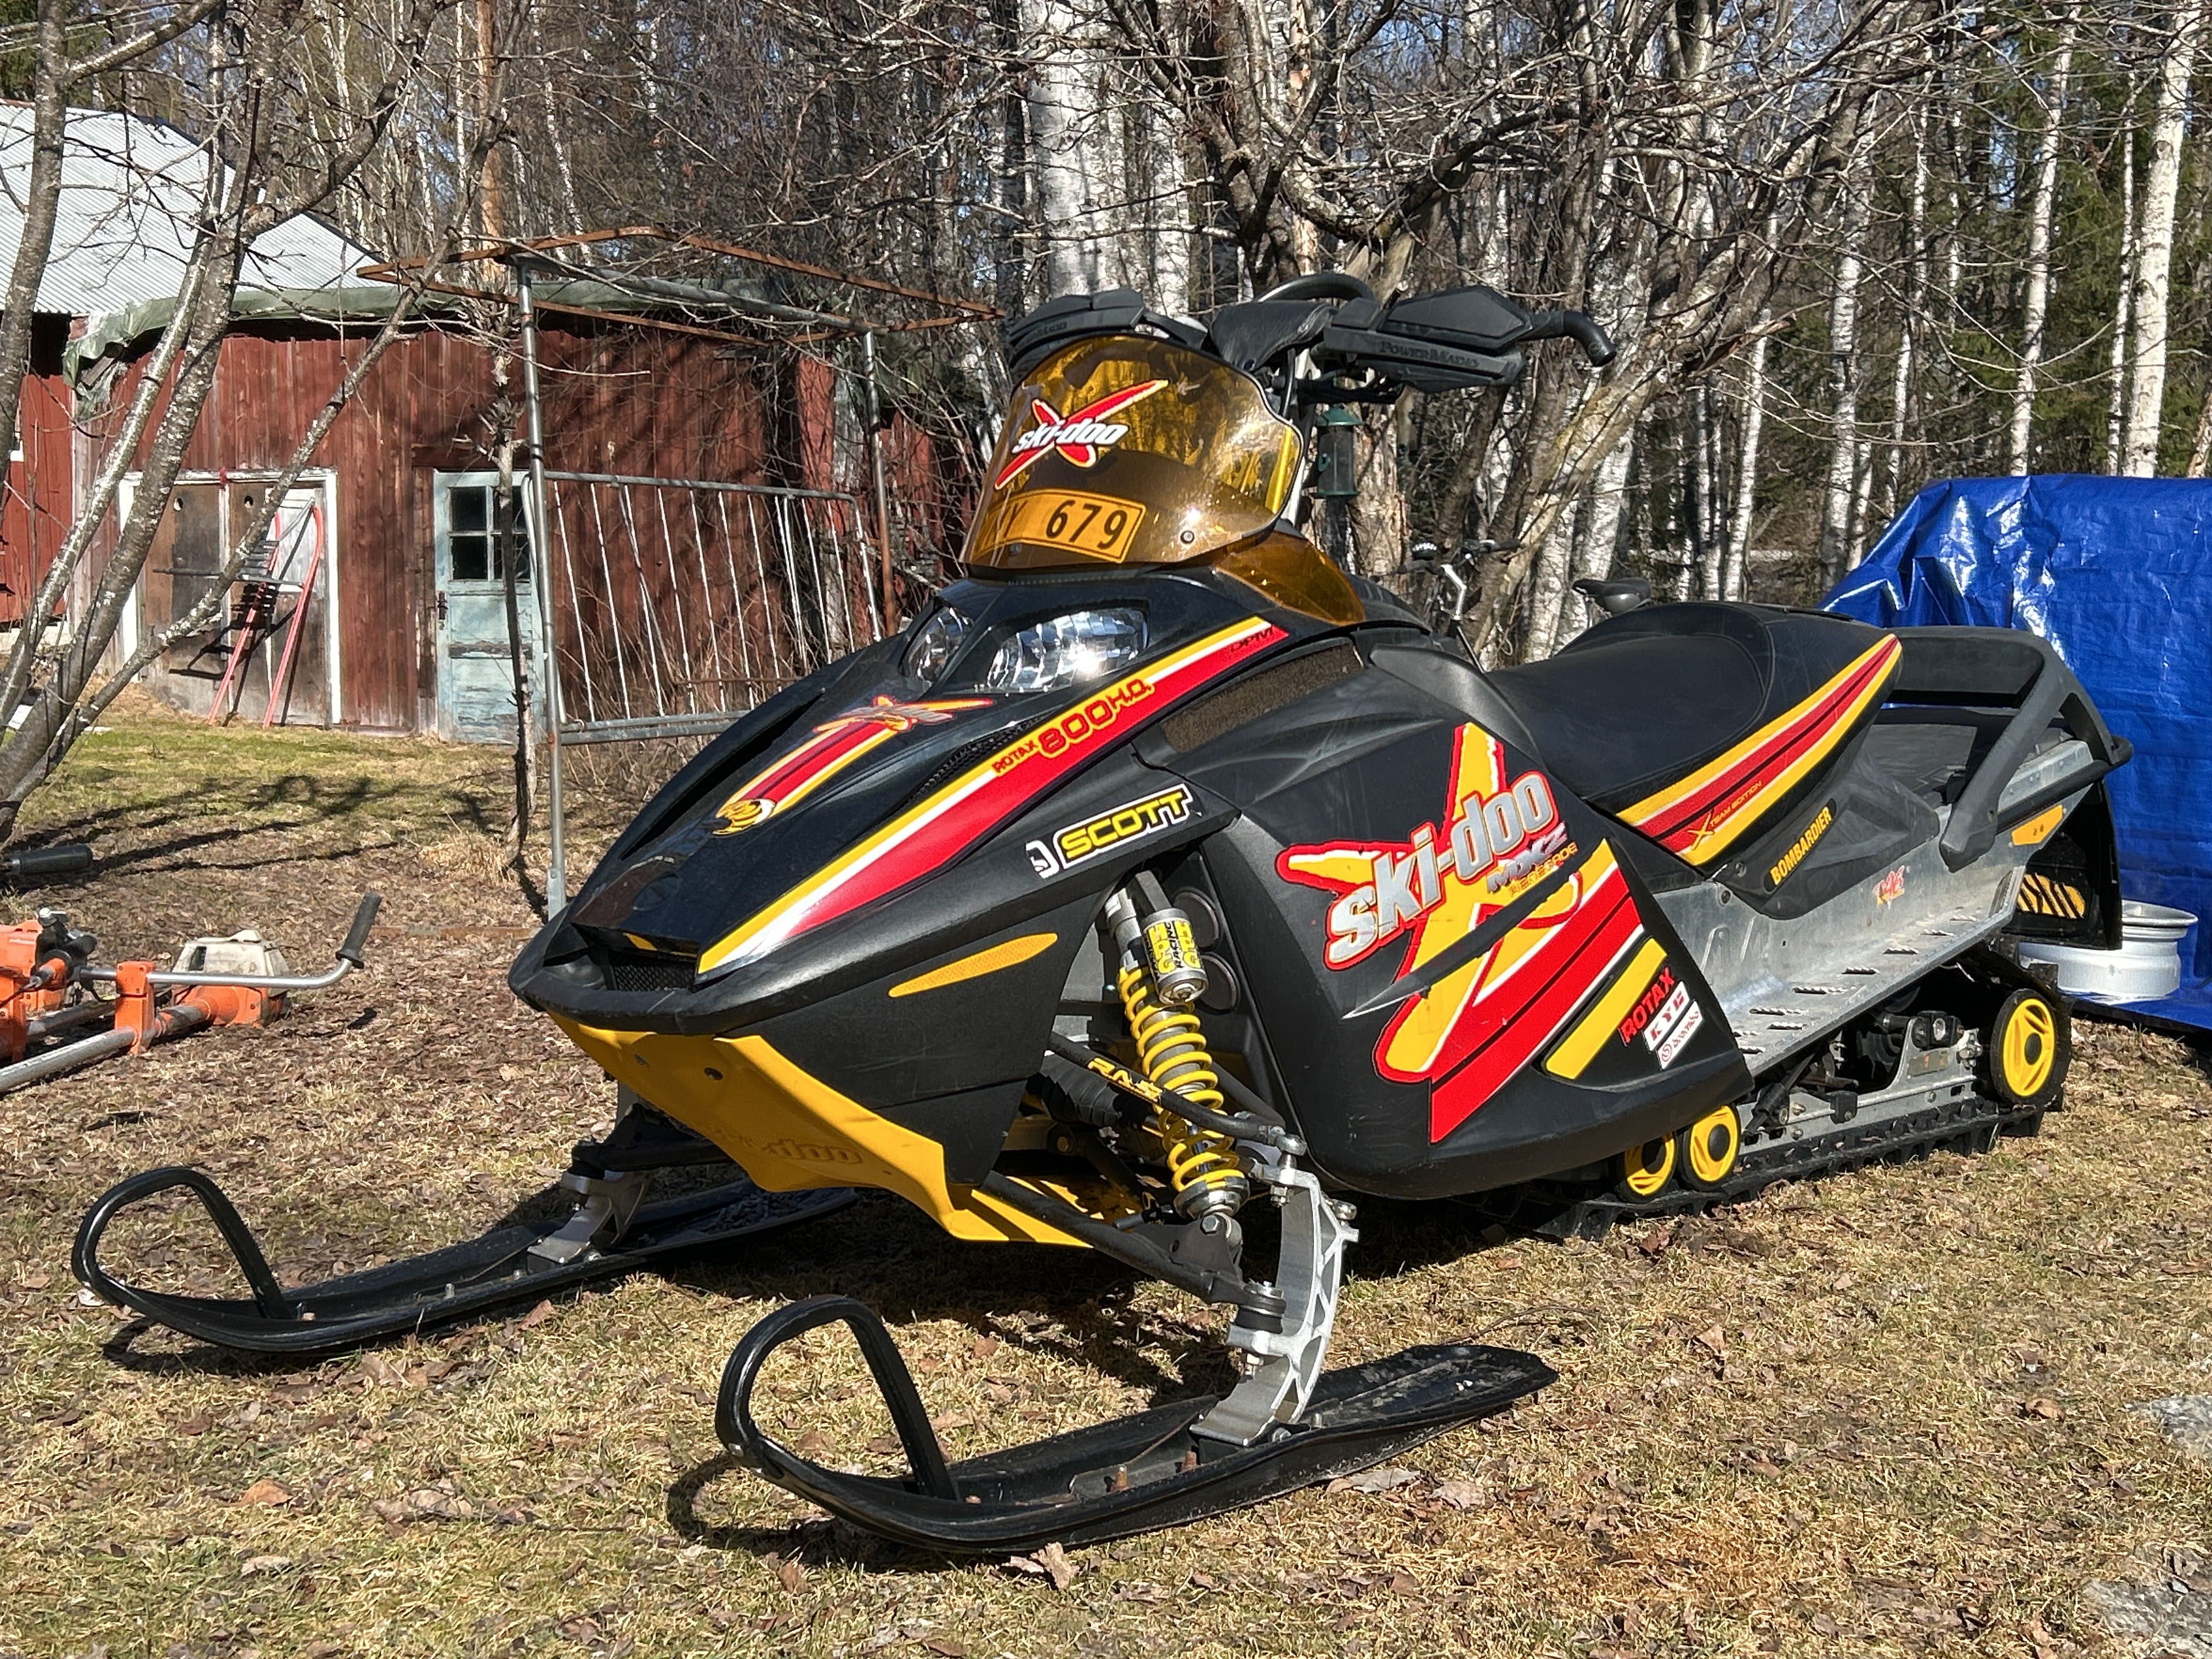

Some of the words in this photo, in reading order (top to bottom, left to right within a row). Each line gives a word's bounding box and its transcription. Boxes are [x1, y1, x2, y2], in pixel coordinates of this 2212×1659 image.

[1012, 417, 1128, 454] ski-doo
[1046, 499, 1128, 549] 679
[992, 740, 1039, 774] ROTAX
[1039, 700, 1113, 754] 800
[1061, 792, 1183, 859] SCOTT
[1709, 805, 1731, 827] TEAM
[1731, 780, 1763, 810] EDITION
[1328, 773, 1555, 964] ski-doo
[1769, 806, 1833, 886] BOMBARDIER
[1165, 921, 1184, 968] RACING
[1620, 966, 1675, 1043] ROTAX
